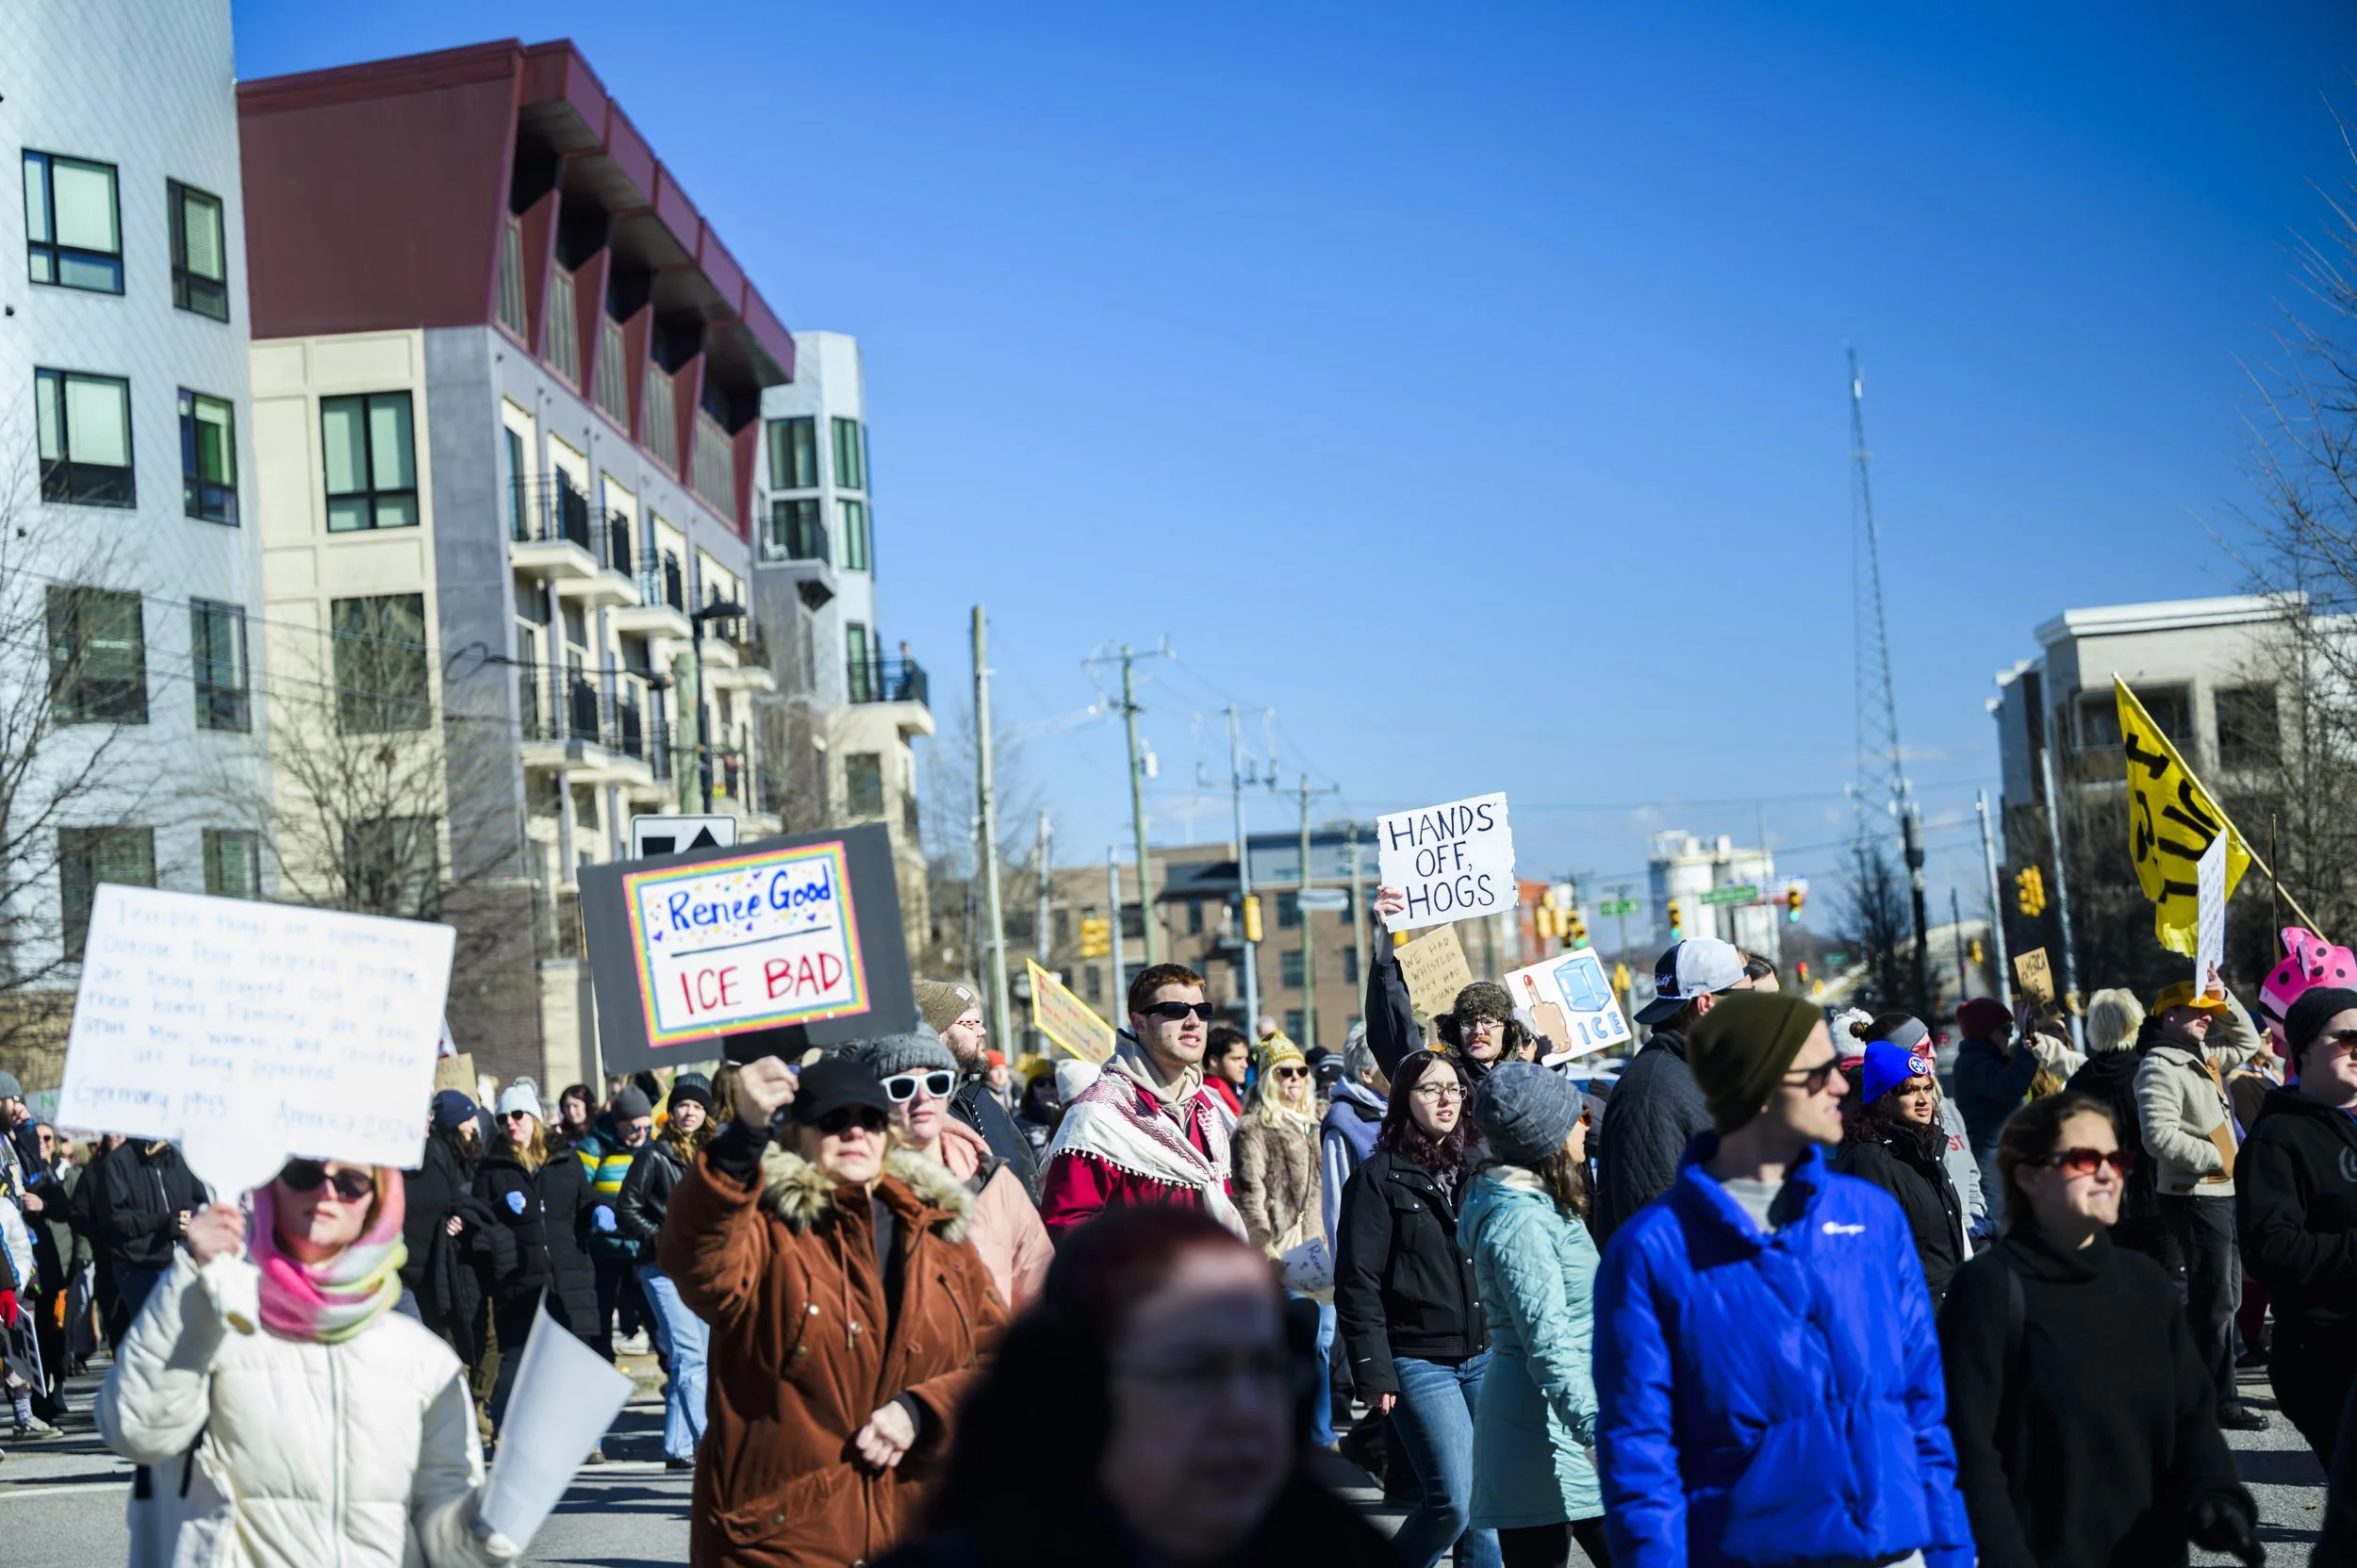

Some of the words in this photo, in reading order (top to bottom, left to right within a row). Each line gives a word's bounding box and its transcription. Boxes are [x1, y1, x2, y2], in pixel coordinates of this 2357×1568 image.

[1389, 803, 1493, 850] HANDS
[1416, 841, 1472, 877] OFF,
[668, 891, 761, 931] Renee
[769, 864, 831, 910] Good
[1406, 874, 1494, 918] HOGS
[1402, 950, 1421, 968] WE
[1428, 938, 1449, 955] HAD
[1411, 951, 1455, 981] WHISTLES
[680, 966, 742, 1015] ICE
[764, 952, 842, 999] BAD
[1413, 979, 1437, 997] THEY
[1442, 967, 1460, 982] HAD
[1577, 1011, 1624, 1045] ICE
